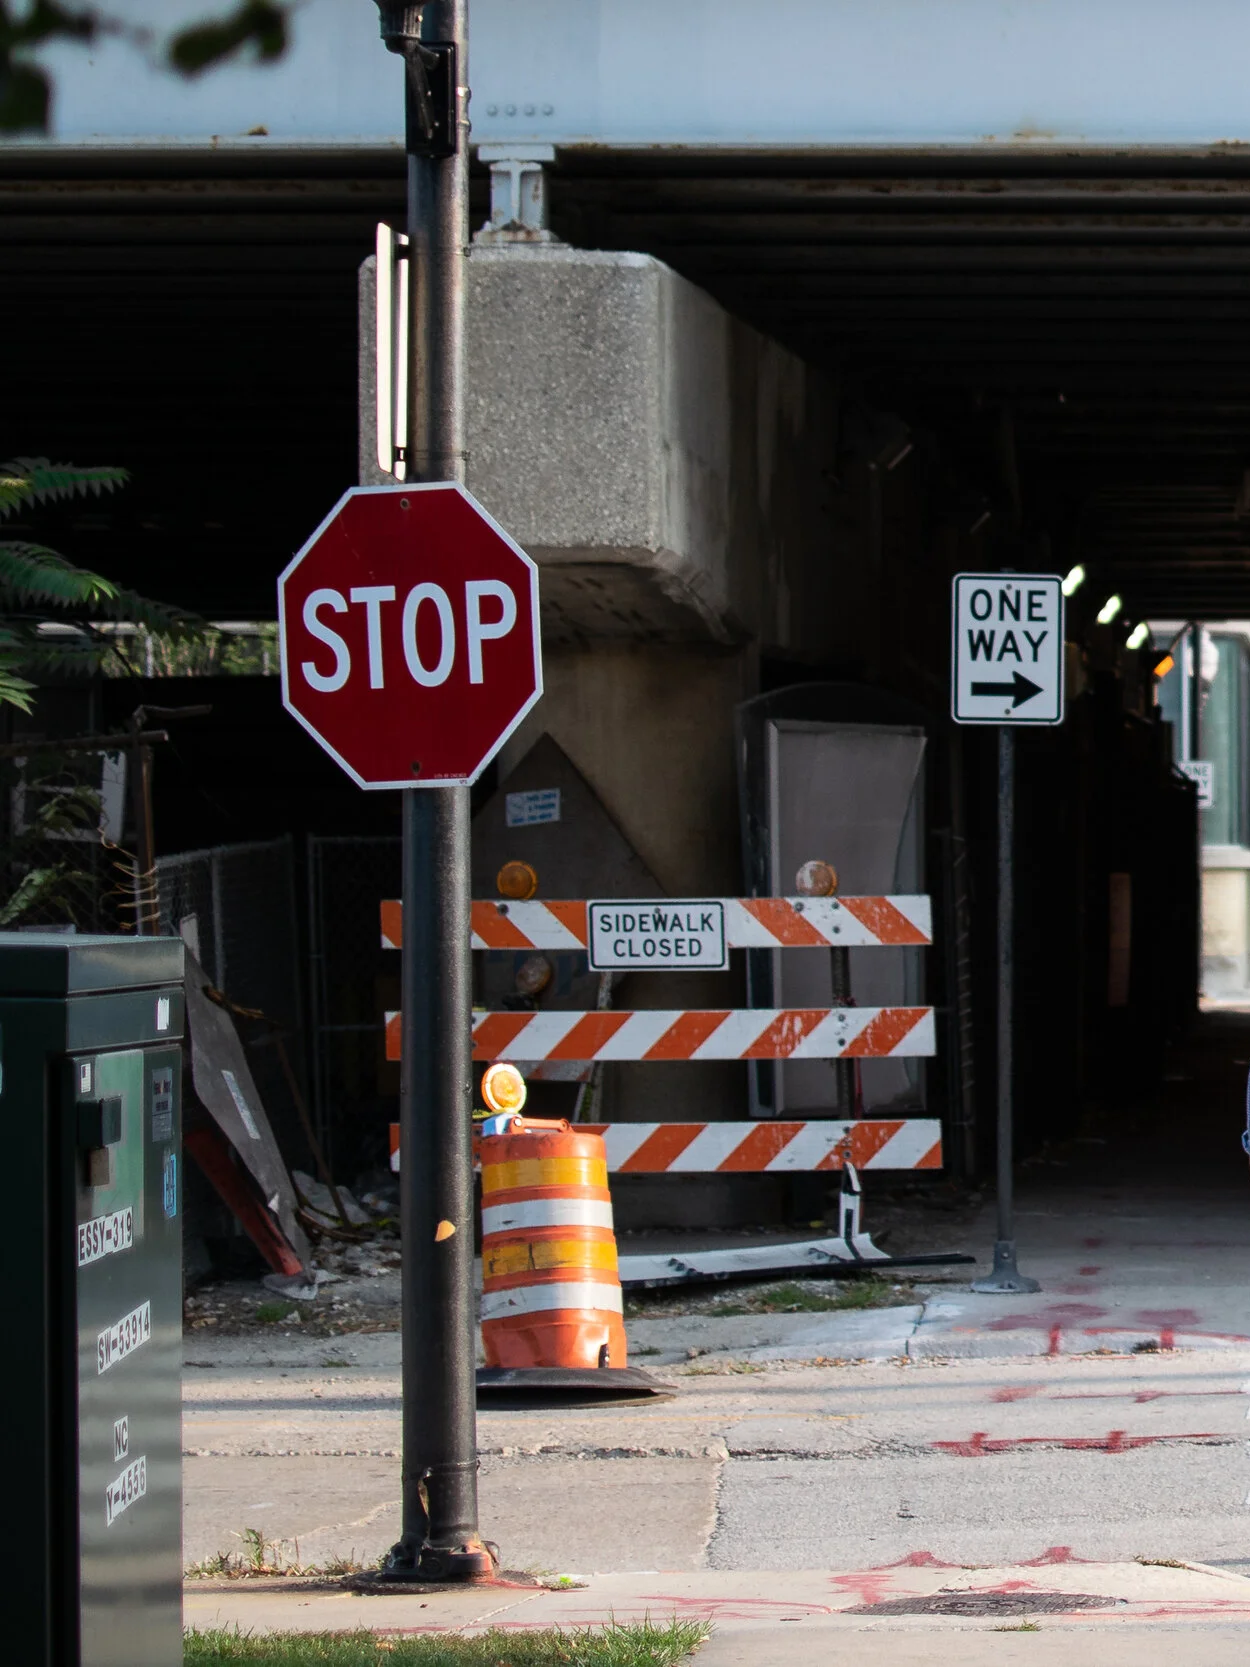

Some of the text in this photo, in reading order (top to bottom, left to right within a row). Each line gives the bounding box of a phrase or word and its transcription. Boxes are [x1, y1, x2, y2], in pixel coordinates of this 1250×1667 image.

[969, 588, 1048, 622] ONE
[301, 579, 517, 693] STOP
[967, 629, 1048, 663] WAY
[1184, 765, 1208, 777] ONE
[600, 912, 714, 933] SIDEWALK
[613, 938, 702, 958] CLOSED
[79, 1210, 132, 1262] ESSY-319
[98, 1305, 150, 1370] SW-53914
[115, 1419, 128, 1457] NC
[106, 1459, 146, 1520] Y-4556
